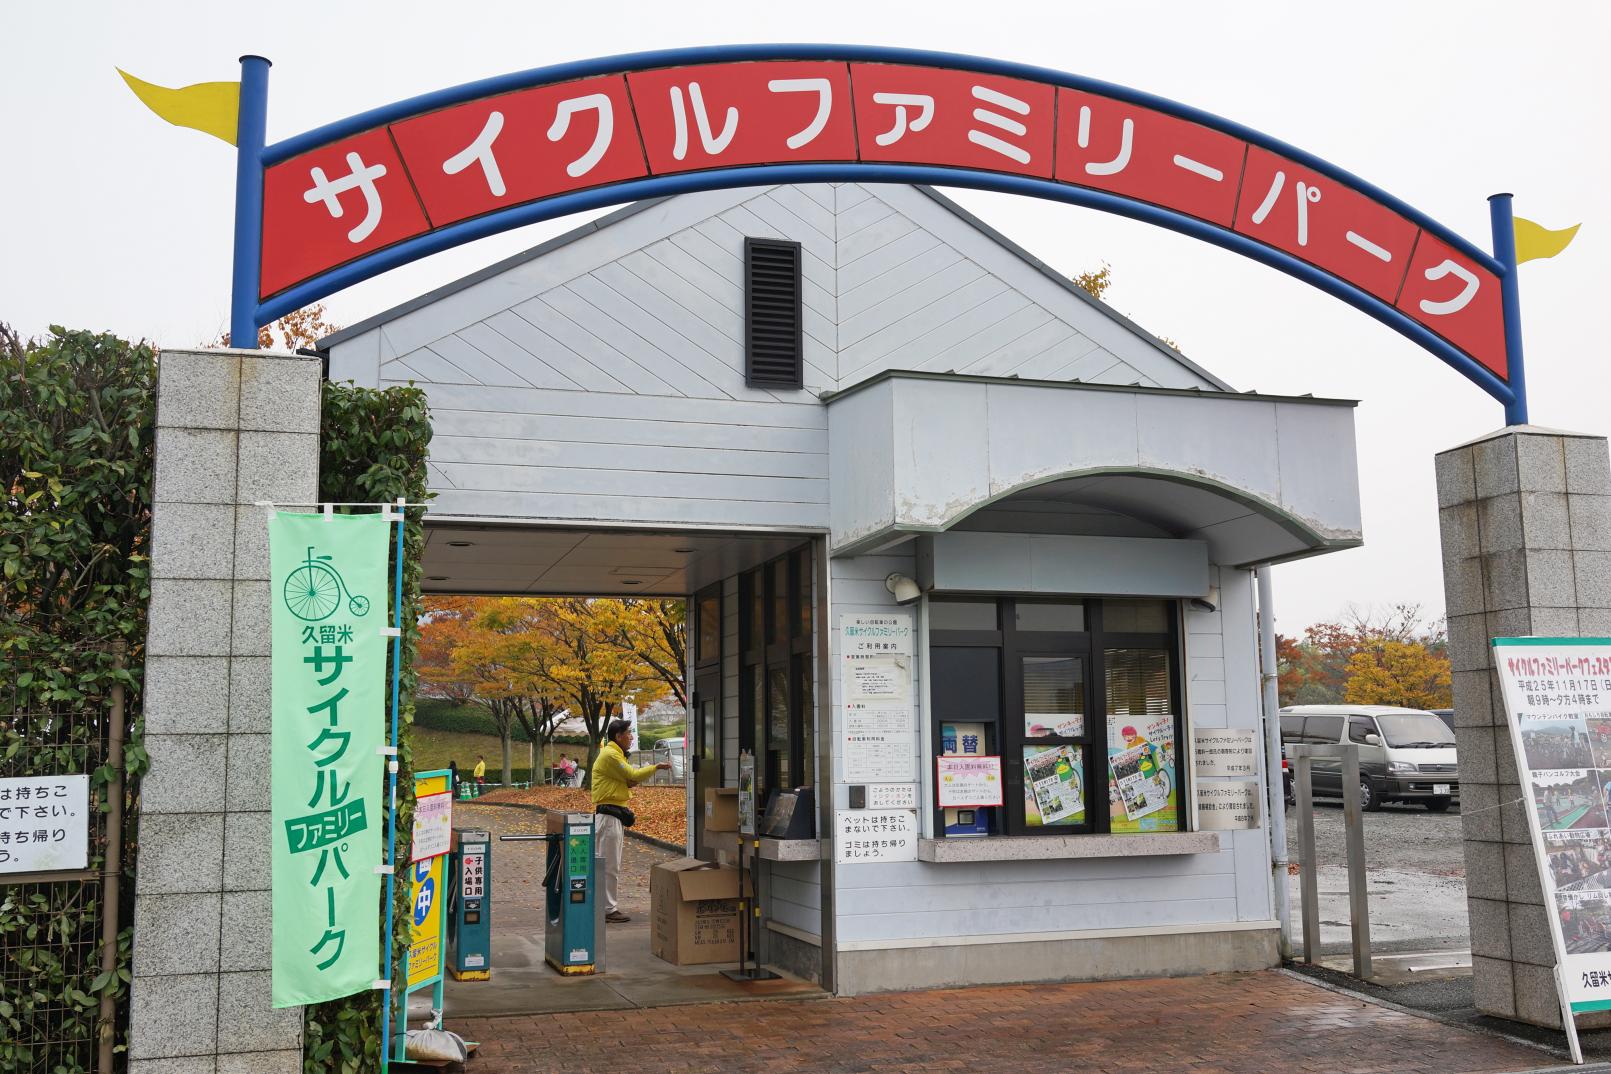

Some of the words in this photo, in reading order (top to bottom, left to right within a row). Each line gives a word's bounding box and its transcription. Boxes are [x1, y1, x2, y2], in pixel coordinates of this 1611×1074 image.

[303, 77, 1481, 315] サイクルファミリーパーク
[302, 624, 354, 645] 久留米
[1508, 656, 1611, 677] サイクルファミリーパークフェスタ
[303, 645, 354, 809] サイクル
[290, 808, 363, 849] ファミリー
[844, 815, 905, 824] ペットは持ちこ
[844, 824, 911, 833] まないで下さい。
[844, 839, 906, 849] ゴミは持ち帰り
[845, 849, 884, 858] ましょう。
[465, 867, 473, 896] 入場口
[474, 856, 483, 896] 子供専用
[310, 842, 350, 971] パーク
